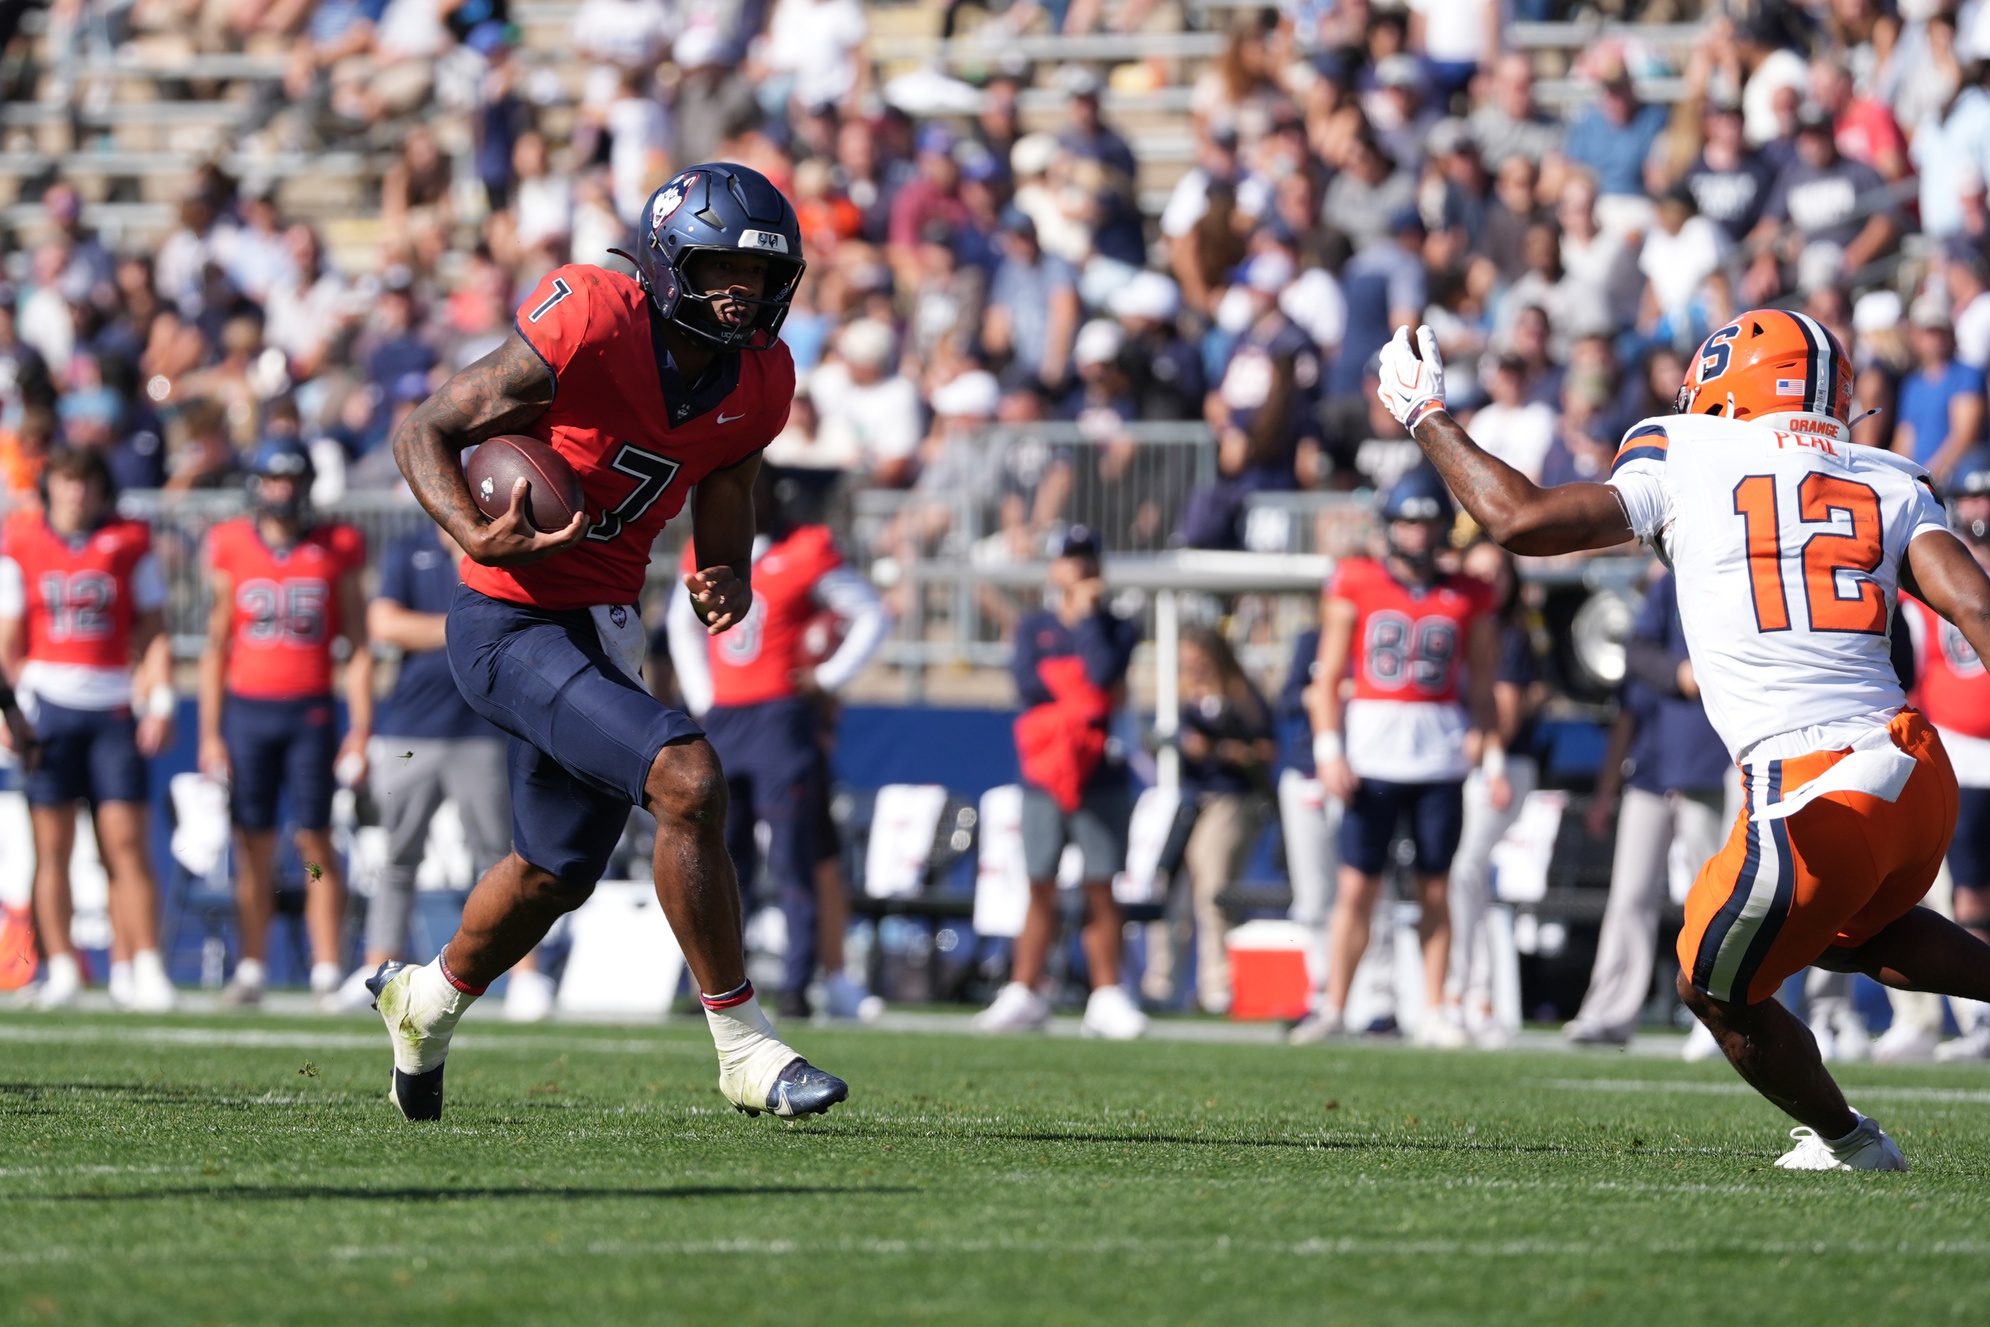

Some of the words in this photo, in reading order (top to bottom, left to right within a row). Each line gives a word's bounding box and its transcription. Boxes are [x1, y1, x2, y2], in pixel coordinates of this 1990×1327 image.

[528, 277, 574, 324] 7
[1700, 324, 1742, 385] S
[1789, 418, 1840, 439] ORANGE
[584, 441, 685, 544] 7
[1732, 470, 1888, 637] 12
[39, 568, 117, 642] 12
[1363, 608, 1461, 695] 89
